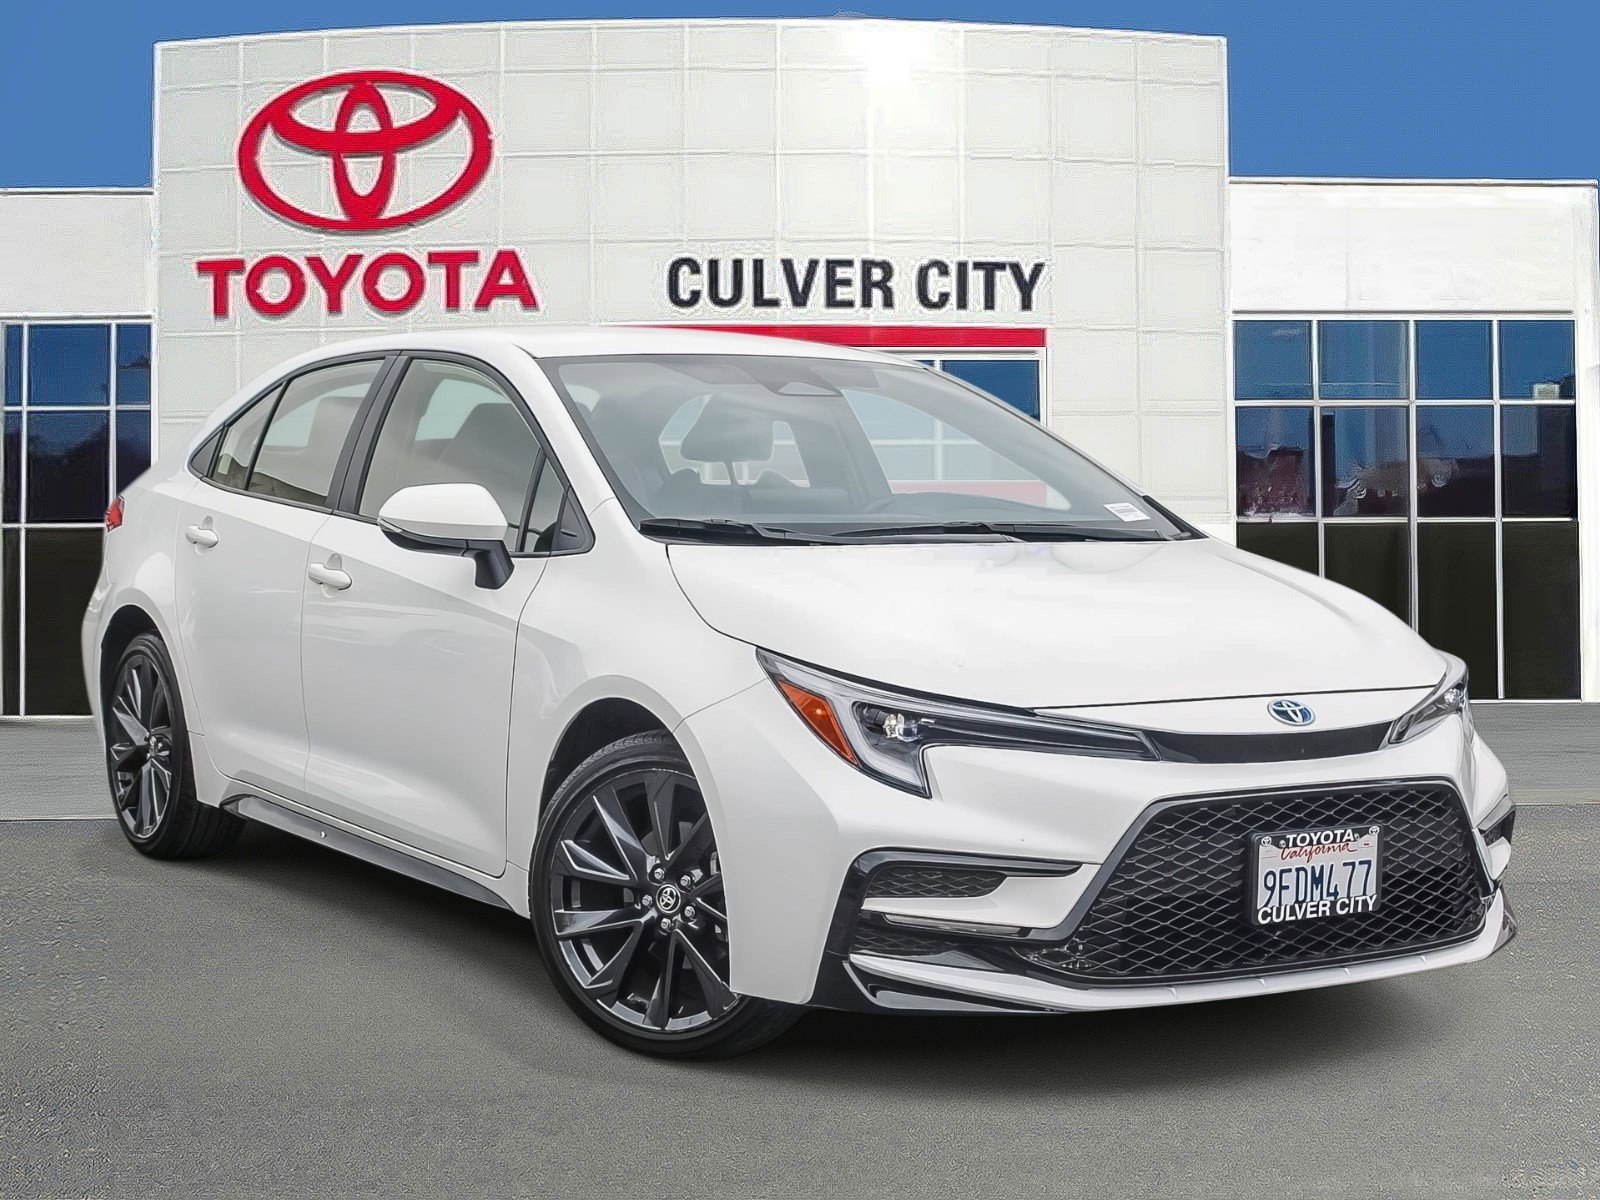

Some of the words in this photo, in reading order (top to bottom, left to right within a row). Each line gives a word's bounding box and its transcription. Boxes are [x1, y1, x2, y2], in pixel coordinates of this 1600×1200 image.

[196, 249, 539, 317] TOYOTA
[667, 257, 894, 309] CULVER
[916, 260, 1045, 311] CITY
[1281, 842, 1357, 863] California
[1286, 829, 1354, 847] TOYOTA
[1263, 860, 1372, 907] 9FDM477
[1257, 901, 1330, 925] CULVER
[1336, 894, 1377, 915] CITY
